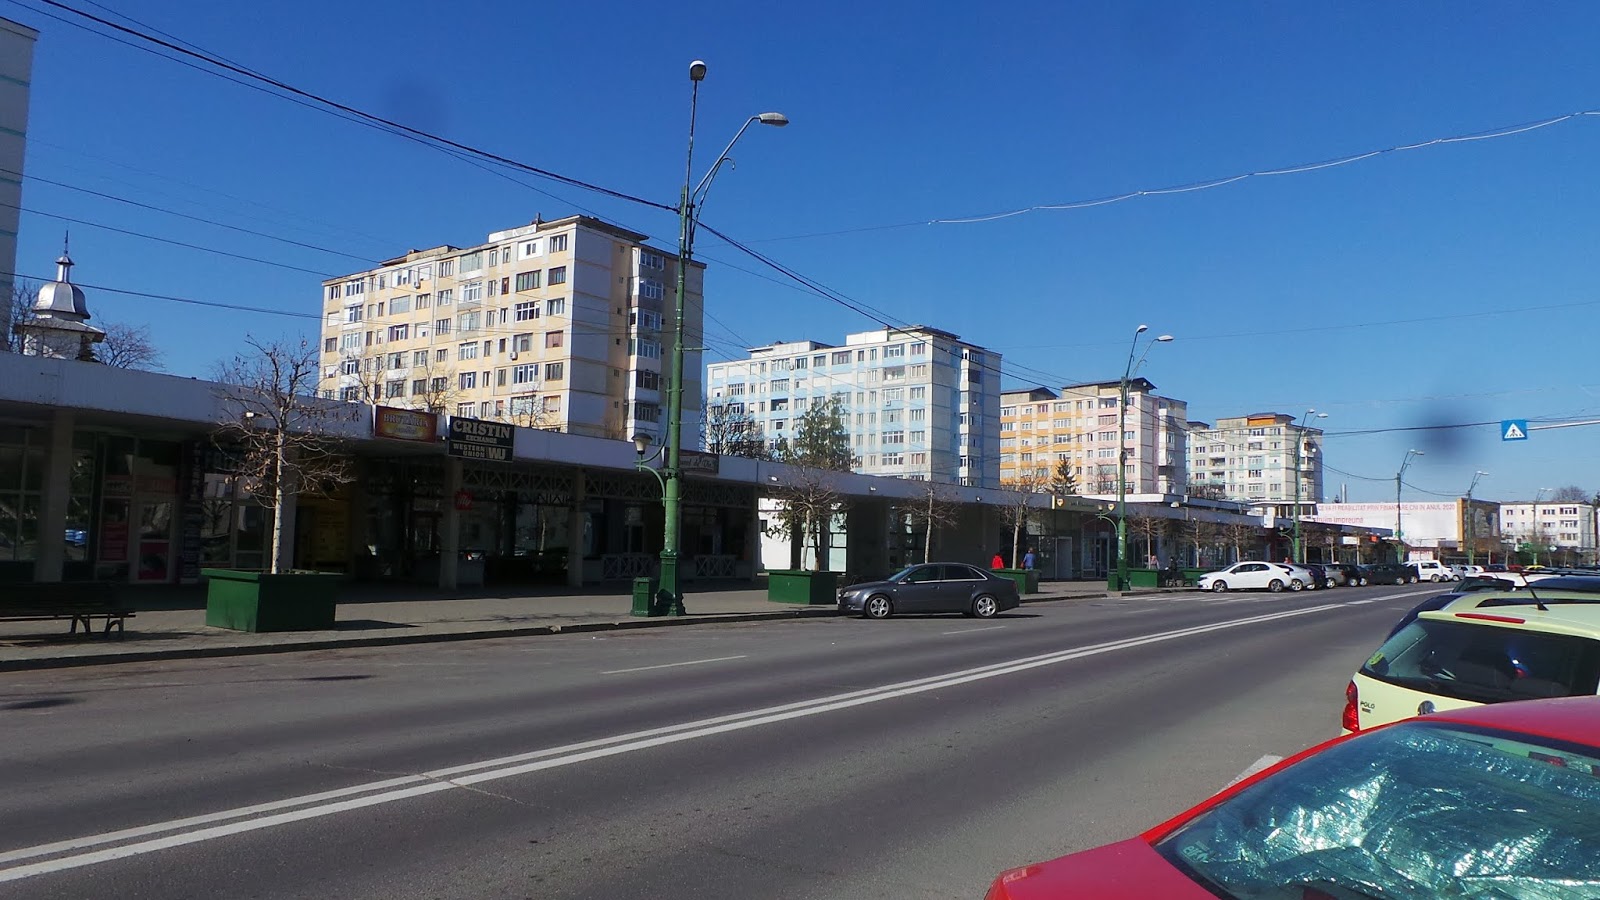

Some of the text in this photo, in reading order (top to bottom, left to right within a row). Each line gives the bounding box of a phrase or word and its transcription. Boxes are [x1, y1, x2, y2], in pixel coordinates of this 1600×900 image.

[452, 420, 511, 439] CRISTIN
[465, 434, 498, 444] EXCHANGE
[453, 443, 486, 452] WESTERN
[462, 450, 486, 458] UNION
[488, 447, 506, 460] WU
[1360, 701, 1375, 709] POLO
